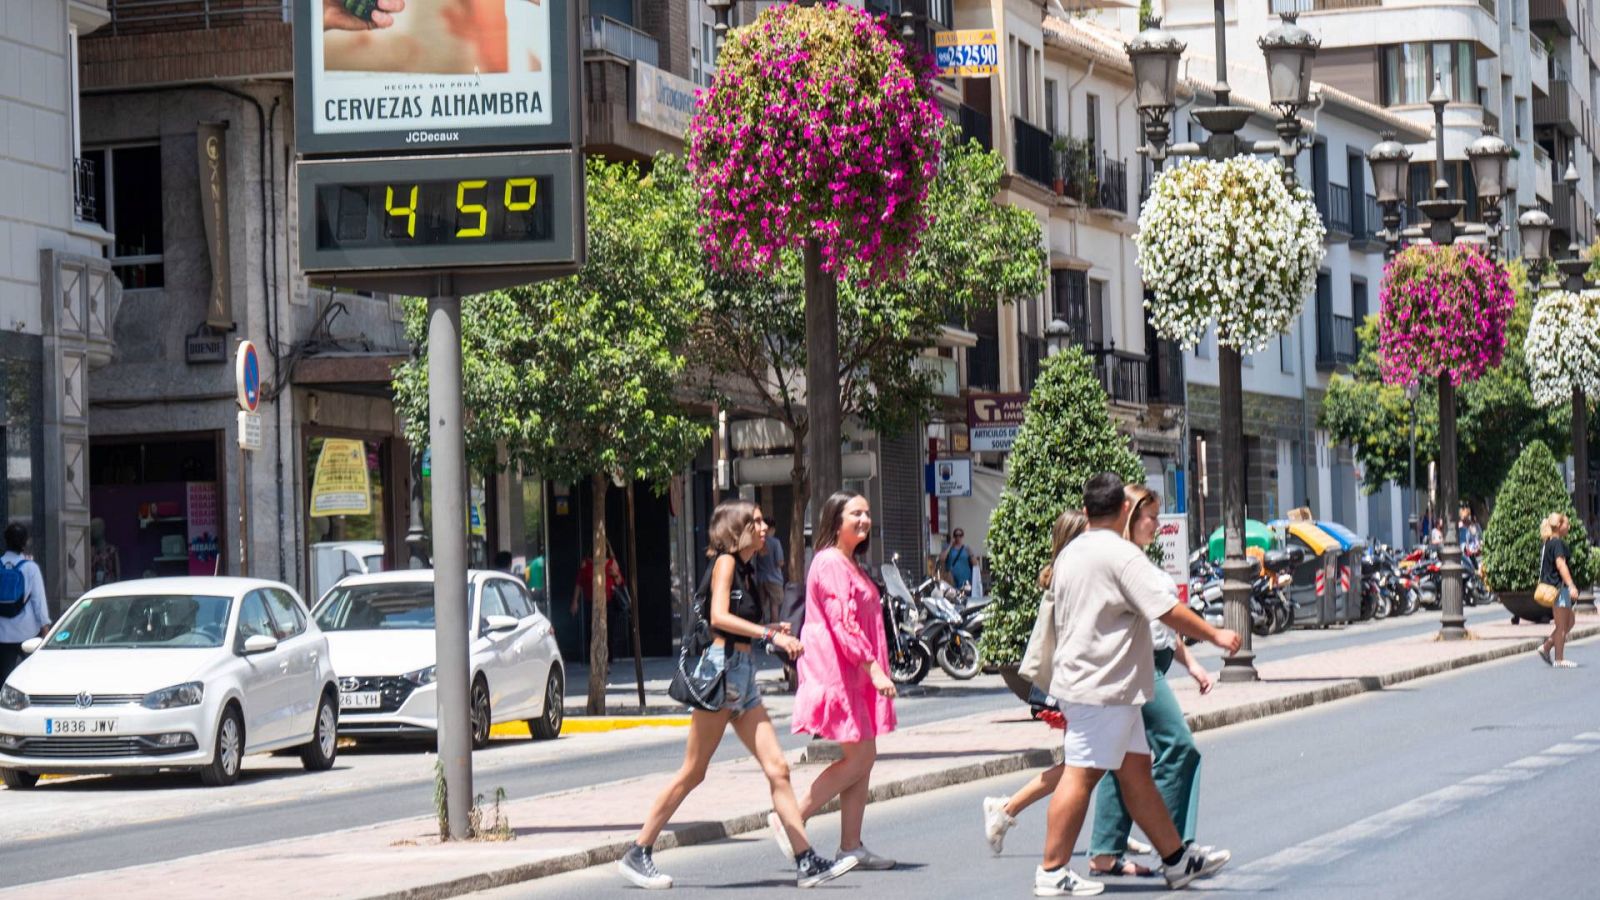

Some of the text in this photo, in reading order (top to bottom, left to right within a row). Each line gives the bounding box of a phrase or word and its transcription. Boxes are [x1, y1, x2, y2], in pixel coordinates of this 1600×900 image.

[325, 91, 543, 122] CERVEZAS ALHAMBRA
[405, 131, 459, 144] JCDecaux
[355, 694, 378, 705] LYH
[54, 720, 115, 732] 3836 JWV
